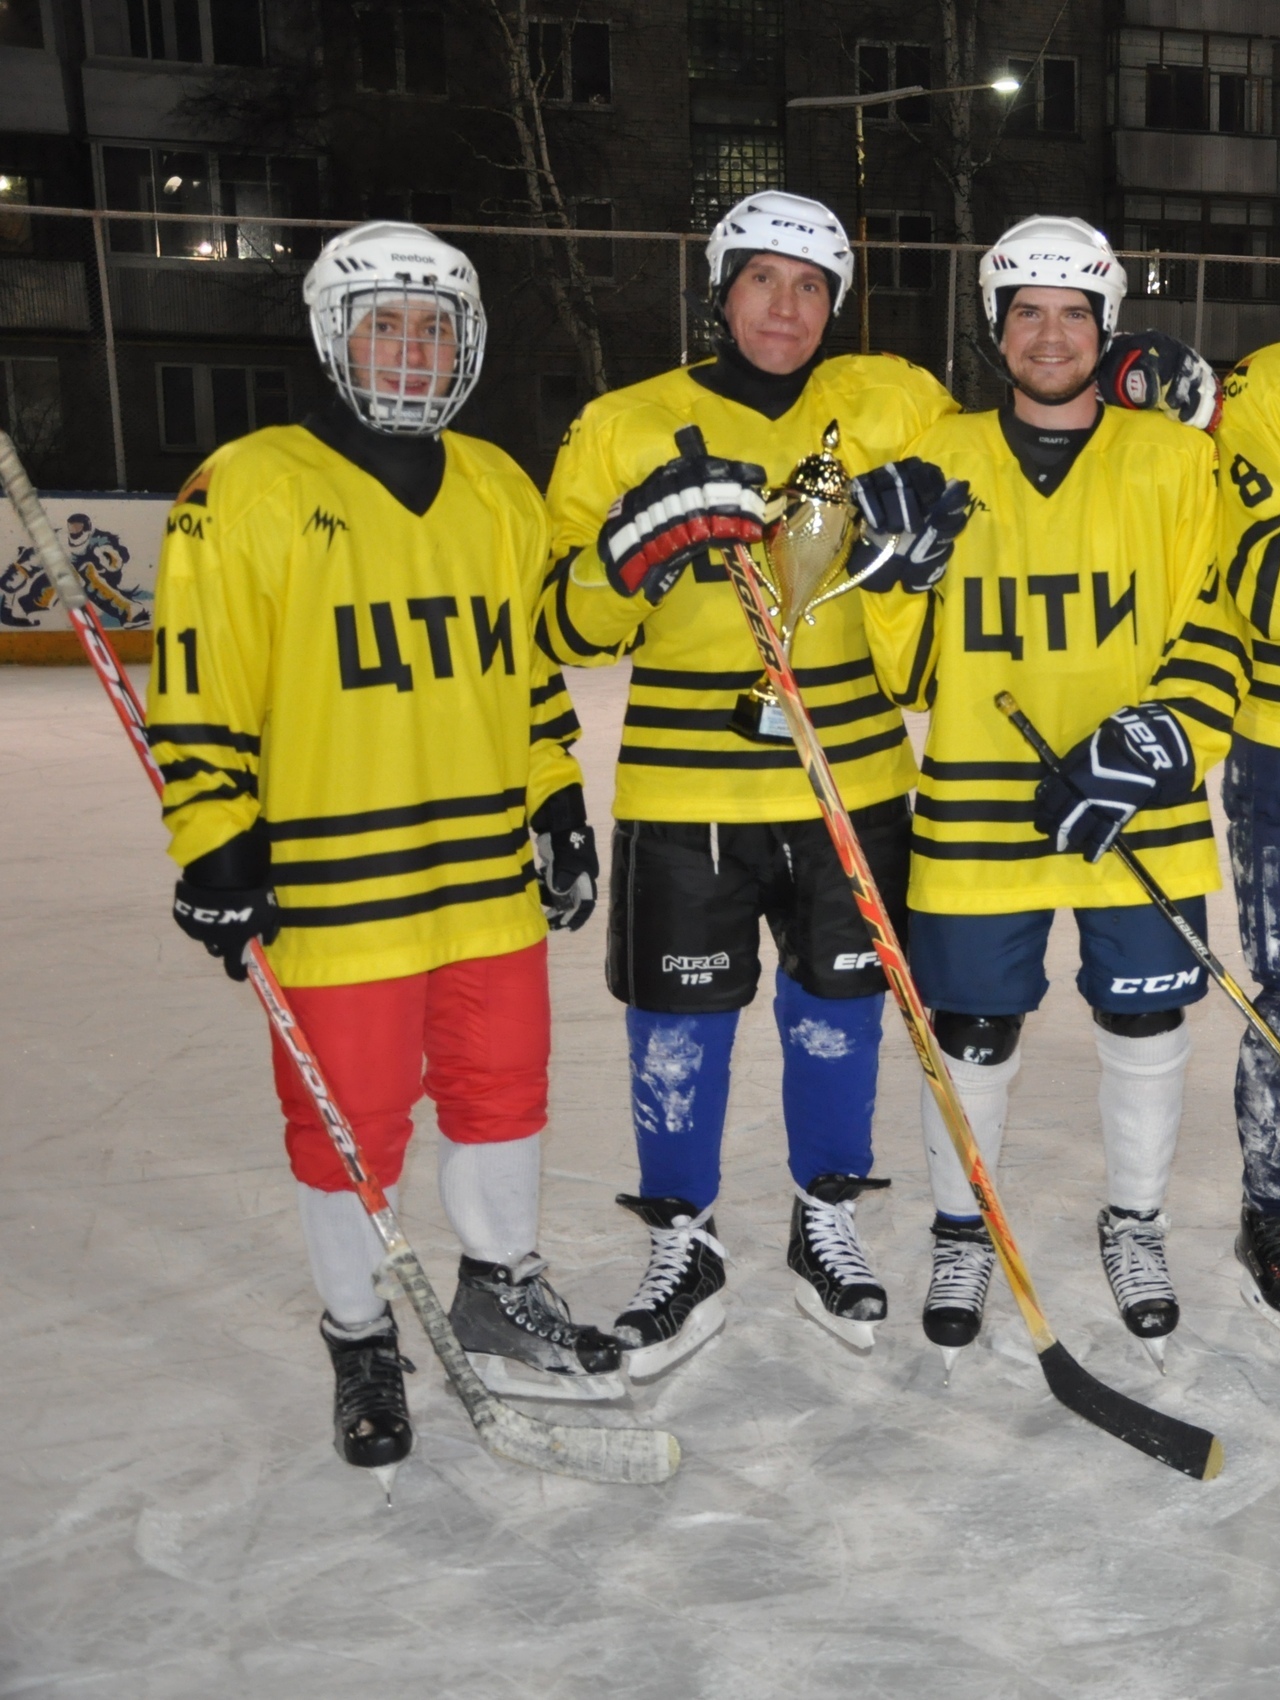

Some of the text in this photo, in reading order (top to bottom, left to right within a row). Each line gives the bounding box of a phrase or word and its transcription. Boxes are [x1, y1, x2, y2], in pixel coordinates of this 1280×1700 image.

[771, 219, 815, 235] EFSI
[390, 252, 437, 265] Reebok
[1028, 253, 1071, 262] CCM
[1229, 453, 1274, 508] 8
[963, 569, 1138, 661] ЦТИ
[333, 595, 517, 693] ЦТИ
[156, 627, 200, 695] 11
[174, 898, 254, 925] CCM
[662, 952, 730, 973] NRG
[832, 952, 884, 971] EF
[681, 972, 713, 986] 115
[1109, 966, 1200, 995] CCM
